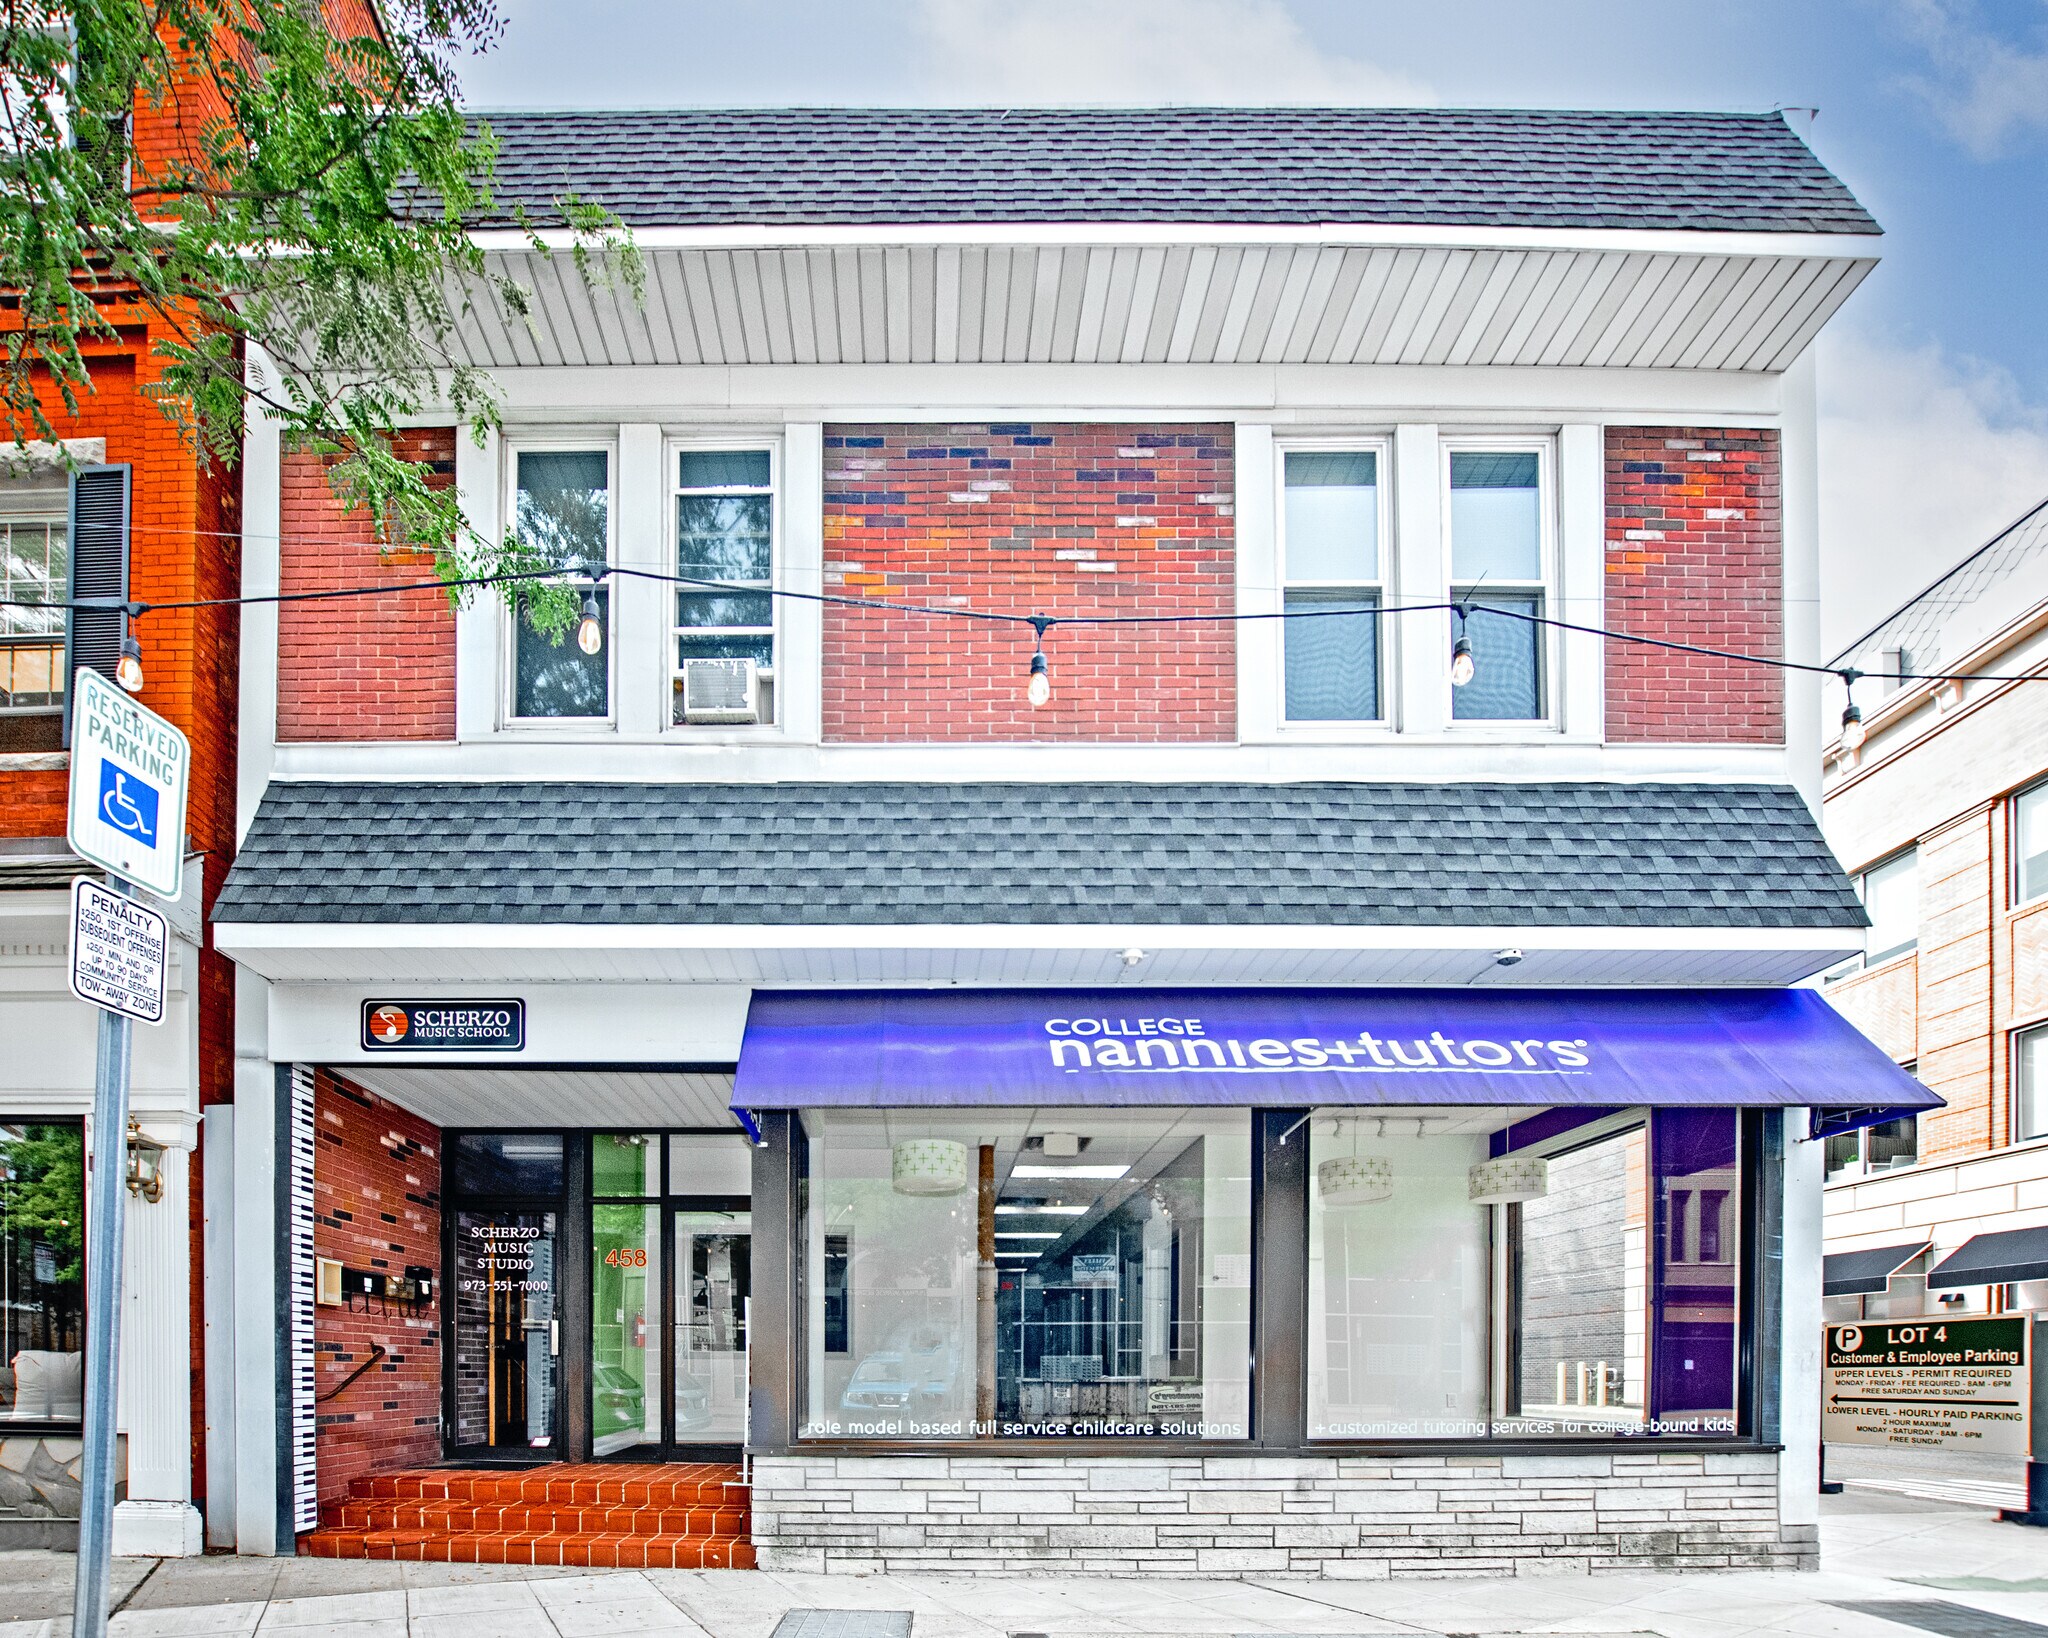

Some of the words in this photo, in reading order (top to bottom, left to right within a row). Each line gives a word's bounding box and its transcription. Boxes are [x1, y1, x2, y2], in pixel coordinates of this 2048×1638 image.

[87, 684, 179, 762] RESERVED
[88, 715, 174, 786] PARKING
[91, 893, 153, 931] PENALTY
[81, 908, 104, 925] $250.
[107, 919, 122, 932] 1ST
[124, 926, 162, 950] OFFENSE
[80, 919, 126, 949] SUBSEQUENT
[127, 940, 162, 964] OFFENSES
[91, 954, 103, 964] UP
[105, 959, 115, 971] TO
[117, 966, 128, 976] 90
[129, 970, 148, 984] DAYS
[125, 957, 141, 970] AND
[143, 964, 155, 976] OR
[80, 961, 126, 986] COMMUNITY
[128, 980, 159, 999] SERVICE
[80, 976, 130, 1004] TOW-AWAY
[132, 996, 158, 1014] ZONE
[414, 1010, 511, 1027] SCHERZO
[1044, 1018, 1206, 1036] COLLEGE
[414, 1027, 456, 1038] MUSIC
[457, 1027, 511, 1038] SCHOOL
[471, 1227, 540, 1239] SCHERZO
[483, 1242, 534, 1254] MUSIC
[477, 1258, 534, 1270] STUDIO
[605, 1248, 648, 1268] 458
[464, 1280, 548, 1292] 973-551-7000
[1887, 1327, 1930, 1344] LOT
[1934, 1325, 1949, 1343] 4
[1830, 1352, 1885, 1364] Customer
[1886, 1351, 1897, 1363] &
[1899, 1350, 1963, 1365] Employee
[1964, 1348, 2020, 1365] Parking
[1834, 1370, 1865, 1378] UPPER
[1866, 1369, 1904, 1378] LEVELS
[1911, 1369, 1951, 1378] PERMIT
[1953, 1369, 2013, 1378] REQUIRED
[1826, 1406, 1859, 1415] LOWER
[1860, 1407, 1891, 1416] LEVEL
[1898, 1408, 1941, 1418] HOURLY
[1943, 1410, 1968, 1419] PAID
[1970, 1411, 2023, 1422] PARKING
[807, 1420, 841, 1435] role
[848, 1420, 903, 1435] model
[909, 1420, 962, 1435] based
[968, 1420, 997, 1435] full
[1003, 1420, 1067, 1435] service
[1072, 1420, 1154, 1435] childcare
[1160, 1420, 1242, 1435] solutions
[1328, 1420, 1418, 1434] customized
[1423, 1421, 1486, 1437] tutoring
[1491, 1420, 1555, 1434] services
[1562, 1418, 1582, 1433] for
[1588, 1416, 1698, 1437] college-bound
[1703, 1415, 1735, 1432] kids
[1856, 1425, 1887, 1433] MONDAY
[1893, 1427, 1935, 1436] SATURDAY
[1912, 1420, 1952, 1428] MAXIMUM
[1889, 1435, 1910, 1443] FREE
[1911, 1437, 1943, 1445] SUNDAY
